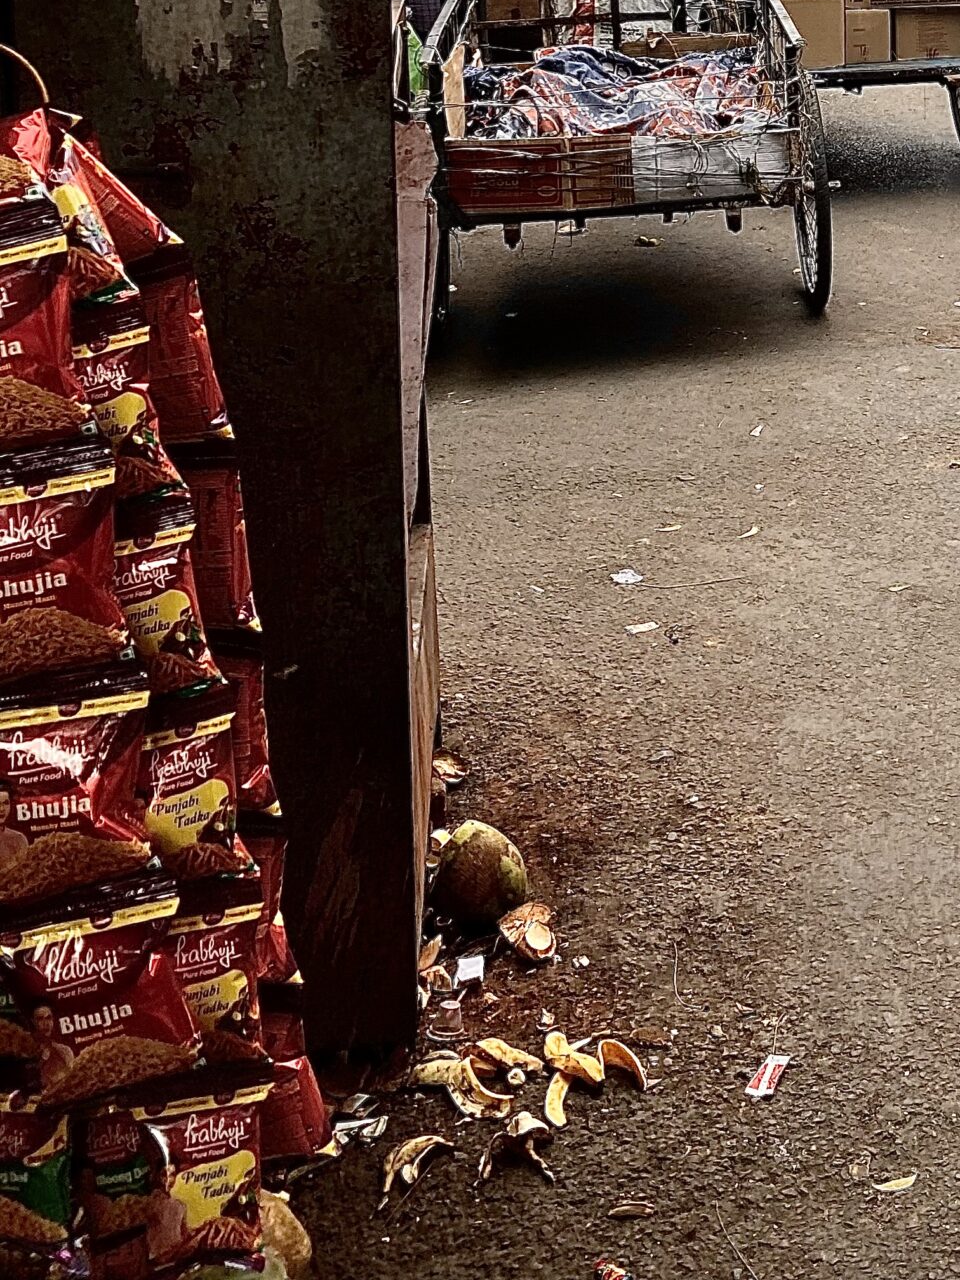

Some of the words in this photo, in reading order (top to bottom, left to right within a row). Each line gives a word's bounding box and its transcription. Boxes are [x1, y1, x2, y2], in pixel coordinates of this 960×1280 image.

[9, 549, 33, 561] Food
[135, 621, 170, 636] Tadka
[18, 774, 43, 786] Pure
[44, 770, 62, 783] Food
[160, 781, 176, 791] Pure
[177, 778, 194, 789] Food
[16, 795, 91, 822] Bhujia
[154, 795, 200, 816] Punjabi
[174, 810, 210, 829] Tadka
[176, 934, 238, 968] Prabhuji
[198, 967, 217, 978] Food
[57, 988, 77, 1000] Pure
[77, 983, 99, 997] Food
[195, 1000, 230, 1017] Tadka
[59, 1002, 133, 1035] Bhujia
[183, 1114, 246, 1147] Prabhuji
[191, 1151, 207, 1160] Pure
[207, 1148, 227, 1158] Food
[181, 1167, 228, 1184] Punjabi
[200, 1183, 236, 1200] Tadka
